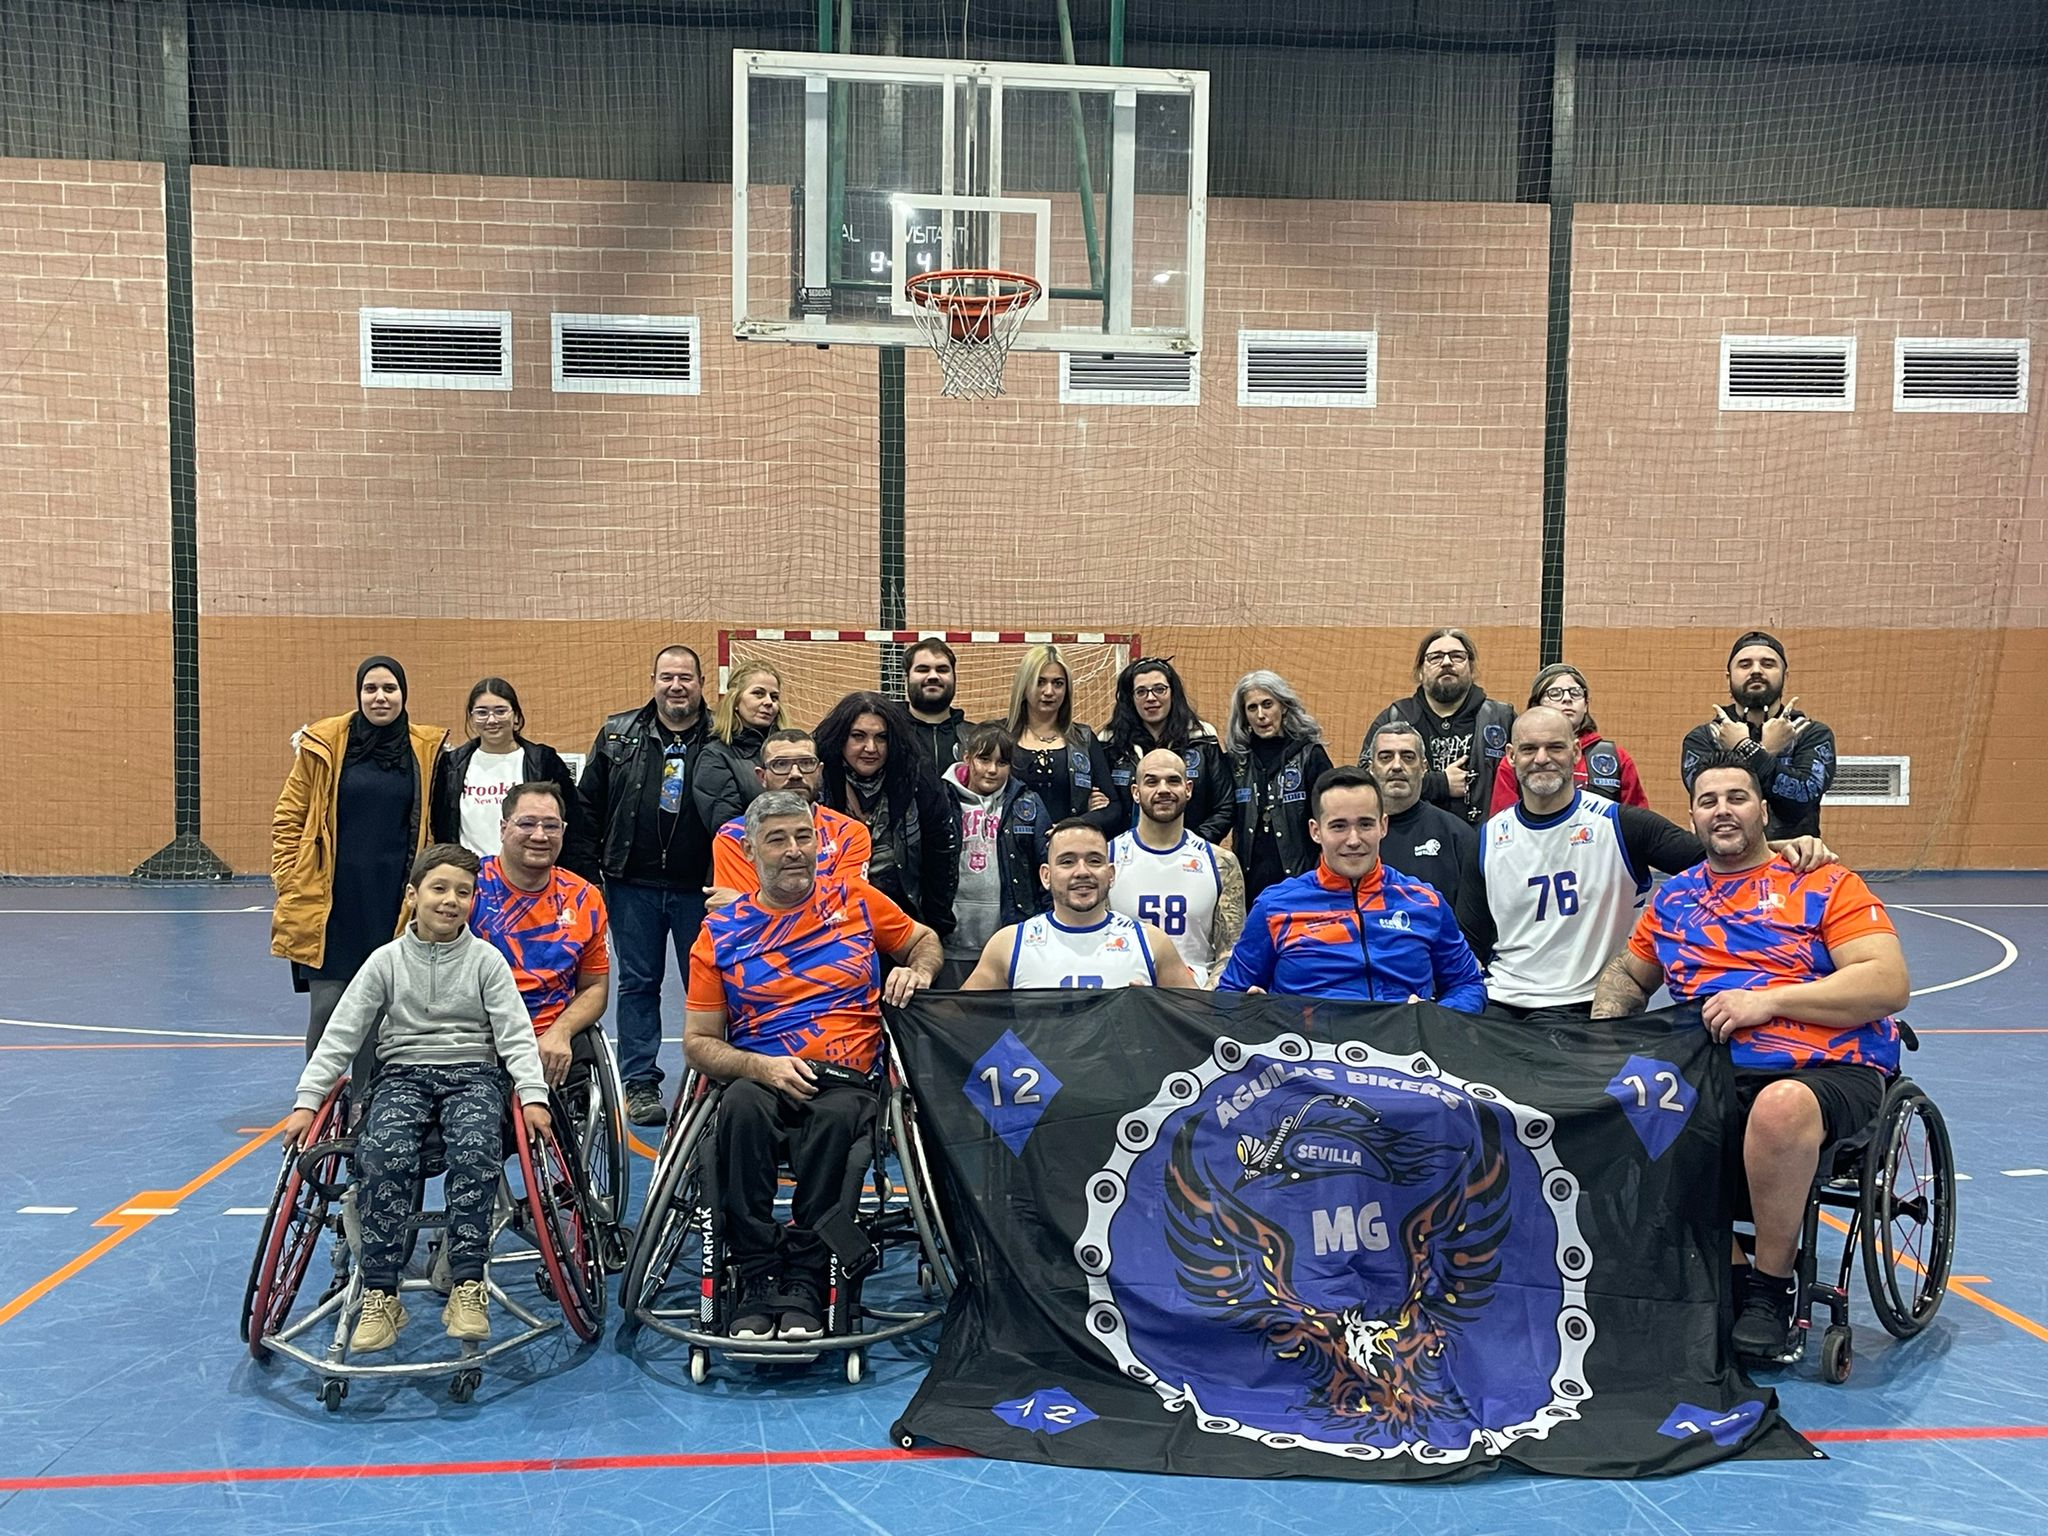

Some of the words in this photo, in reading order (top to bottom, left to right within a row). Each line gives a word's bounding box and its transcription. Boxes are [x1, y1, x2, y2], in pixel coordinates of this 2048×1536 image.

[916, 252, 932, 273] 4
[474, 797, 492, 805] New
[1138, 894, 1187, 936] 58
[1527, 870, 1579, 923] 76
[979, 1066, 1040, 1106] 12
[1215, 1063, 1336, 1130] ÁGUILAS
[1345, 1070, 1465, 1111] BIKERS
[1622, 1071, 1685, 1112] 12
[1297, 1144, 1362, 1167] SEVILLA
[701, 1206, 714, 1276] TARMAK
[1311, 1201, 1391, 1256] MG
[1015, 1397, 1078, 1424] 12
